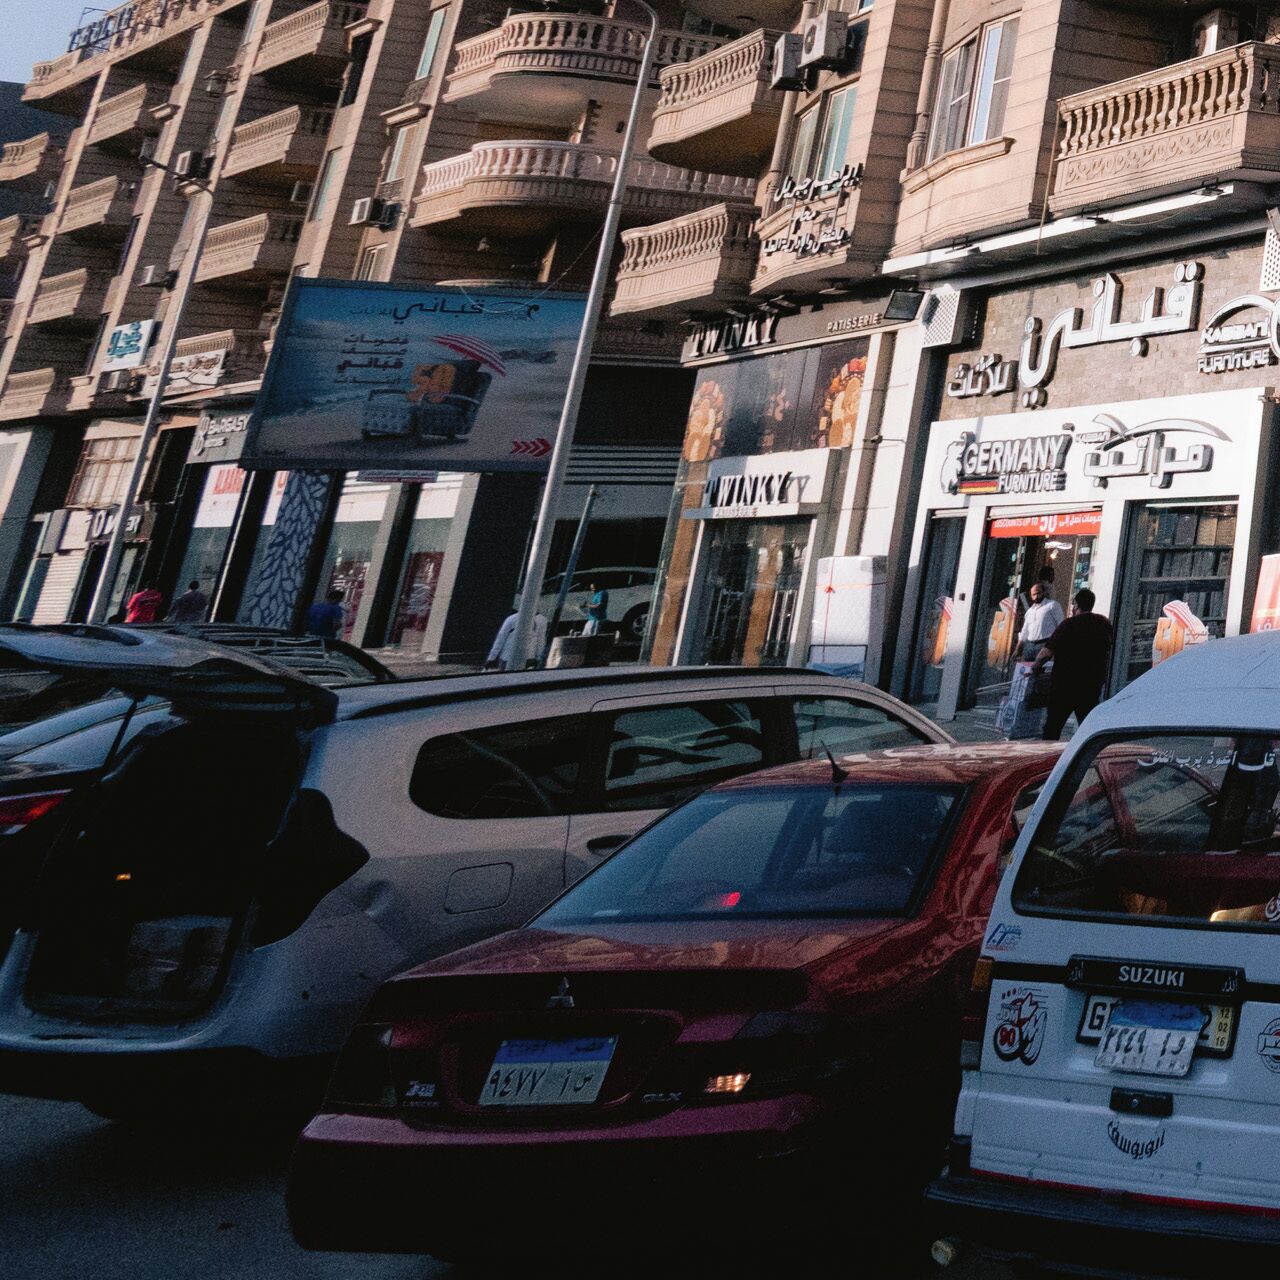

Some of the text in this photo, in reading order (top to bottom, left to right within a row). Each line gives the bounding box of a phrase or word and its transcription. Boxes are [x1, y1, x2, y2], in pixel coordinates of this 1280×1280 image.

[1019, 261, 1203, 408] قباني
[963, 435, 1068, 474] GERMANY
[997, 471, 1065, 493] FURNITURE
[1118, 964, 1186, 988] SUZUKI
